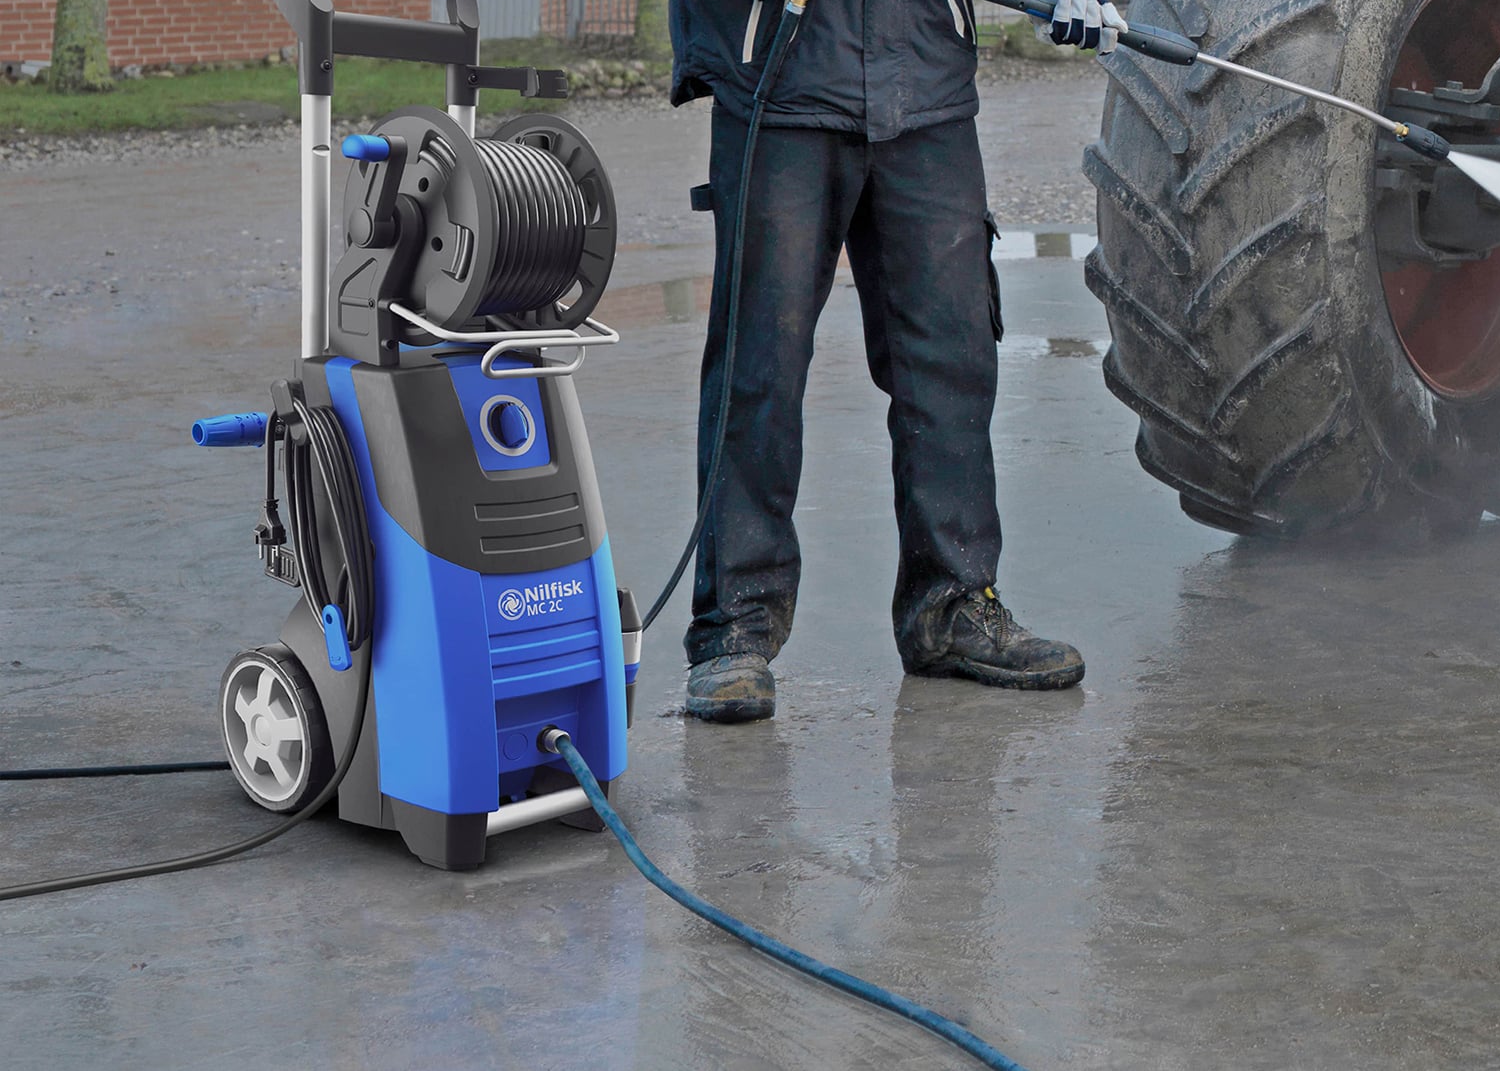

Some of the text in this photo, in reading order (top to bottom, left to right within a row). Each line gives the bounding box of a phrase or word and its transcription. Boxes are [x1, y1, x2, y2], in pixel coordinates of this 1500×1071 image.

[524, 579, 584, 603] Nilfisk
[527, 599, 564, 616] MC 2C
